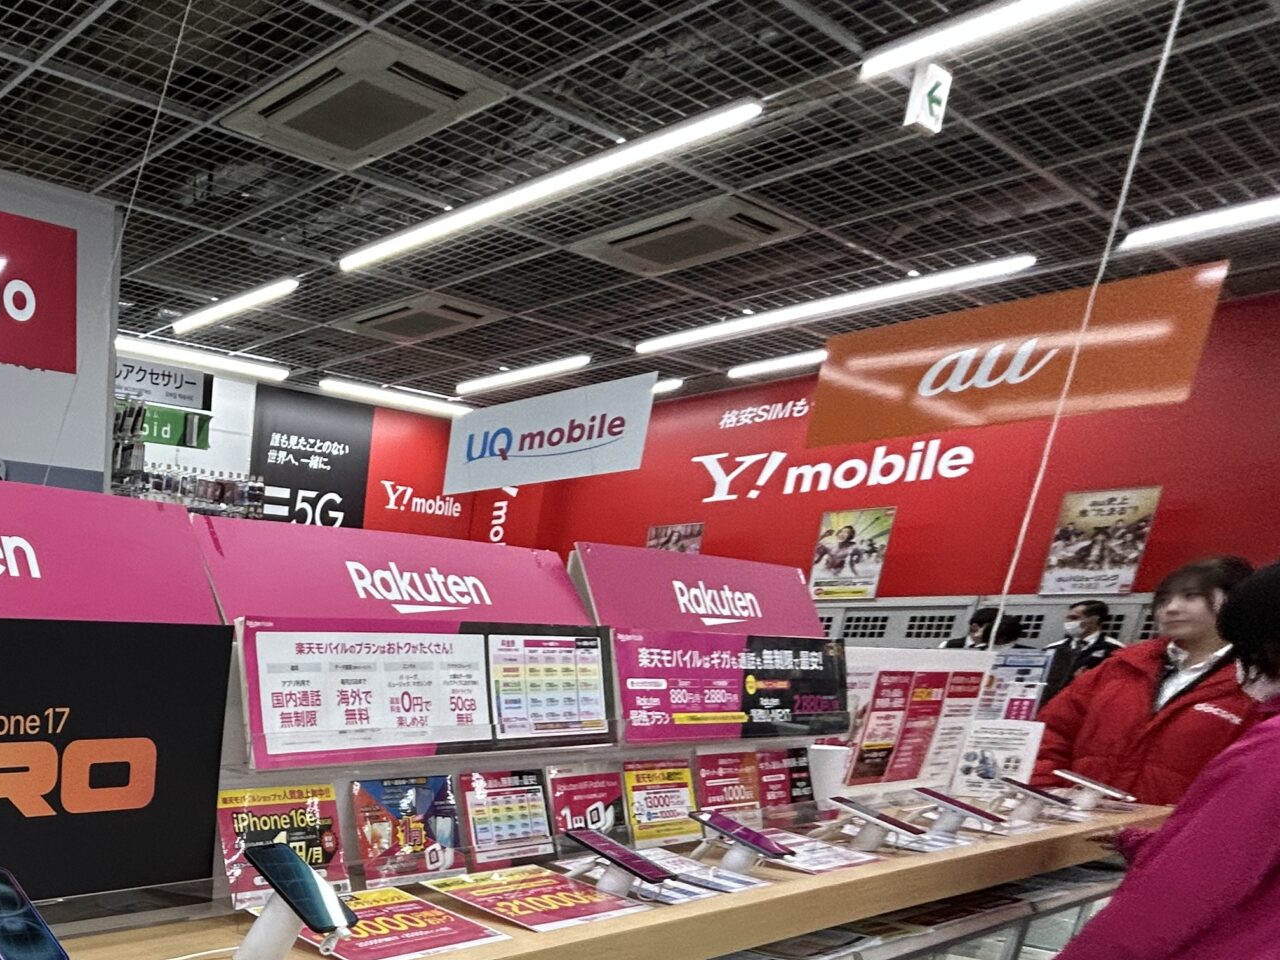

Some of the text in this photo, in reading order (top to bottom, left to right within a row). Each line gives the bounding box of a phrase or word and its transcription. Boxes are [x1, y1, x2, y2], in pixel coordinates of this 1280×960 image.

[917, 338, 1059, 397] au
[269, 431, 350, 456] 誰も見たことのない
[466, 413, 627, 462] UQ mobile
[344, 560, 493, 606] Rakuten
[671, 580, 763, 618] Rakuten
[271, 689, 323, 708] 国内通話
[336, 689, 373, 707] 海外で
[43, 707, 70, 735] 17
[279, 710, 318, 729] 無制限
[232, 811, 290, 833] iPhone
